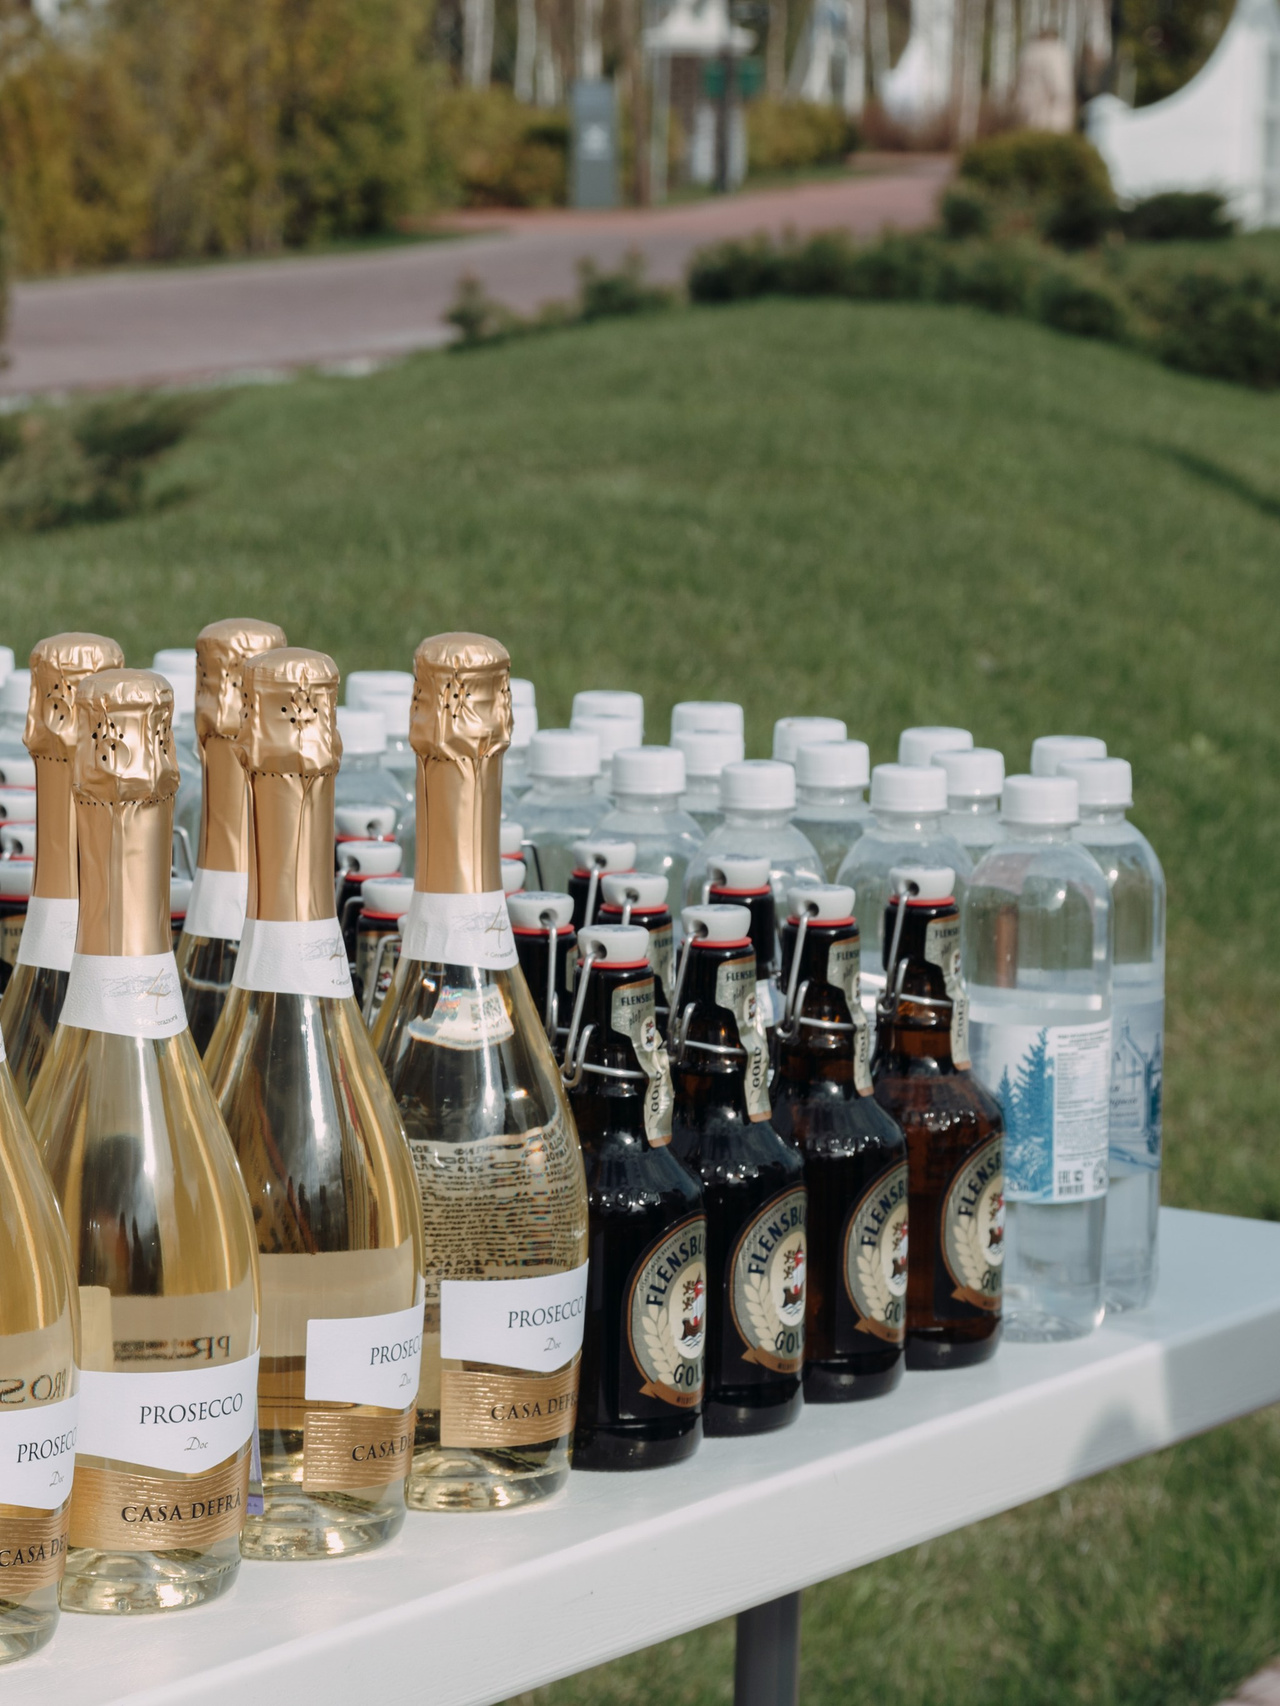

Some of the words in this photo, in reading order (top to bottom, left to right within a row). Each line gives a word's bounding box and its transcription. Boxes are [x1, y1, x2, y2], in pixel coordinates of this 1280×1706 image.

[651, 1071, 663, 1112] GOLD
[508, 1296, 583, 1329] PROSECCO
[139, 1393, 243, 1425] PROSECCO
[491, 1402, 542, 1421] CASA
[184, 1436, 208, 1451] Doc
[352, 1440, 395, 1462] CASA
[121, 1505, 183, 1523] CASA
